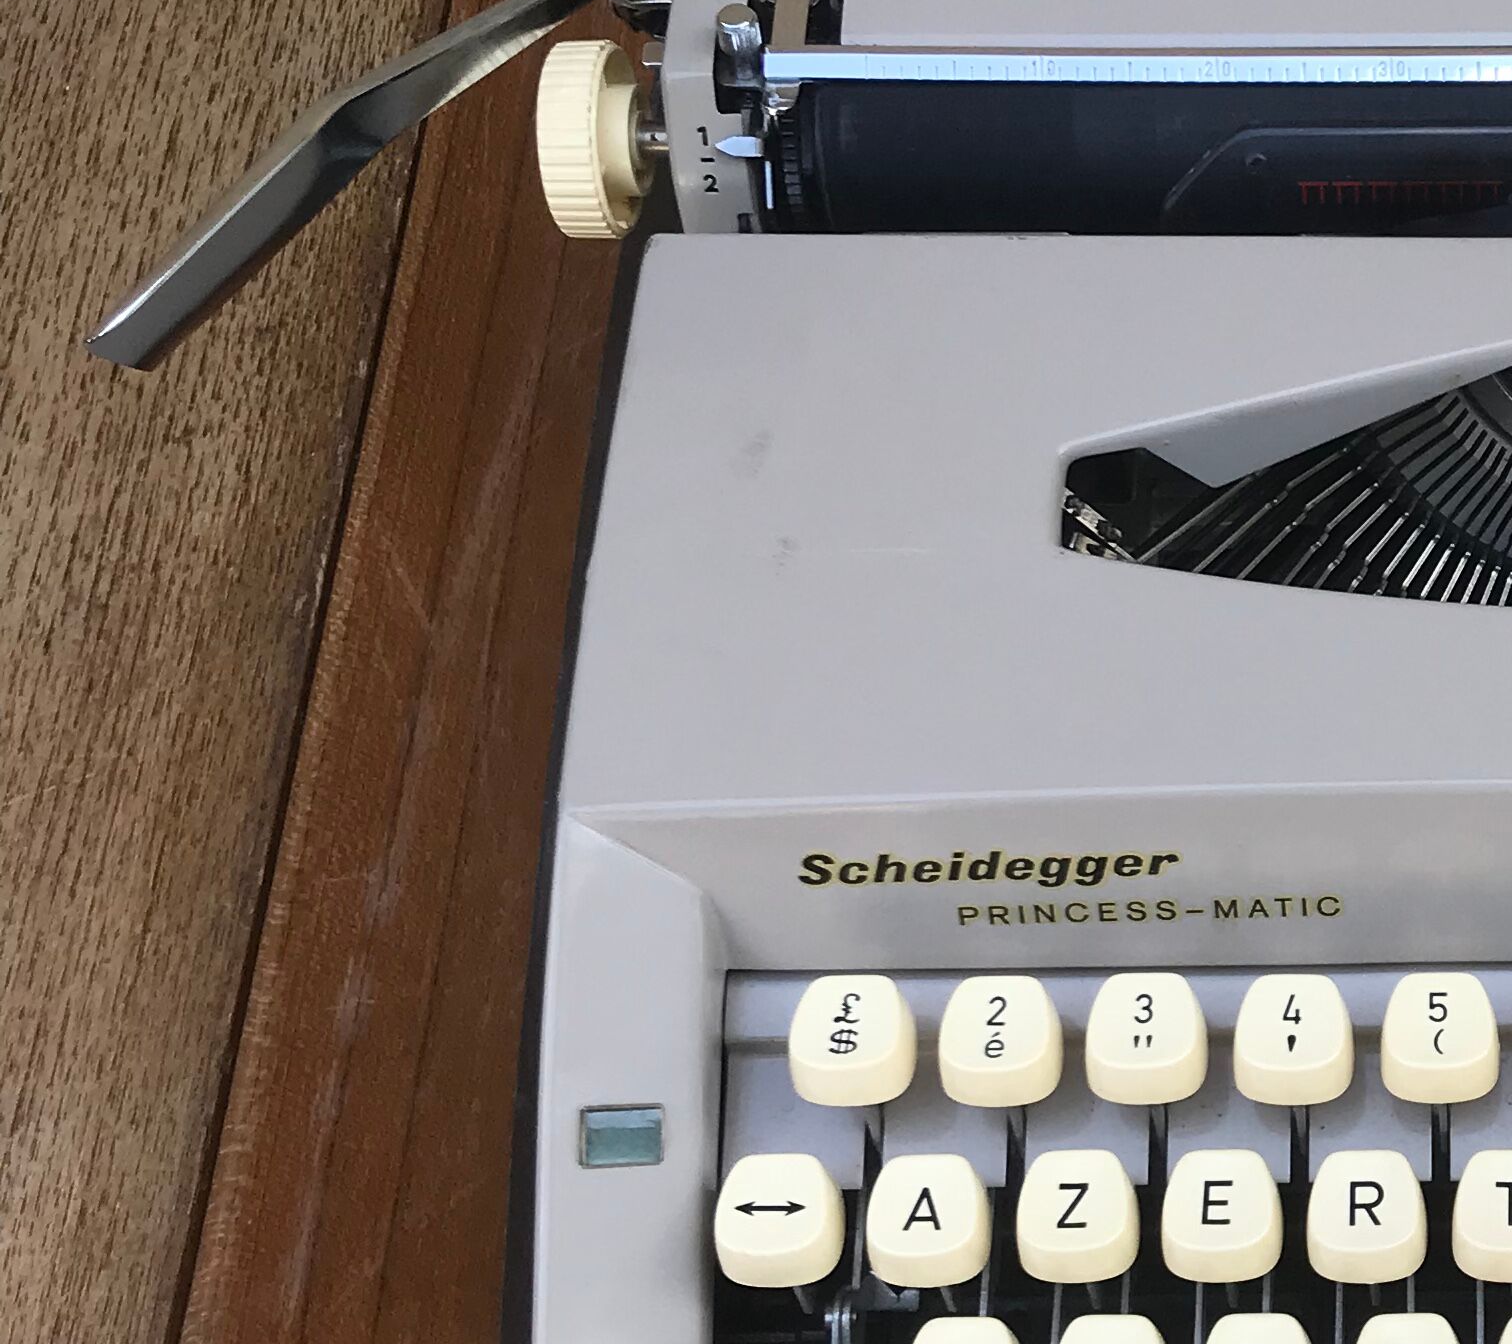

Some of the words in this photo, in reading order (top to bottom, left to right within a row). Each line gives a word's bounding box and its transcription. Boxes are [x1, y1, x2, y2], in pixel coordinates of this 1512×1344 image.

[1030, 59, 1056, 77] 10
[1203, 59, 1232, 78] 20
[1377, 57, 1406, 77] 30
[696, 126, 709, 147] 1
[703, 174, 720, 193] 2
[798, 850, 1180, 888] Scheidegger
[957, 896, 1341, 926] PRINCESS-MATIC
[833, 993, 861, 1024] £
[986, 996, 1007, 1027] 2
[1134, 993, 1153, 1024] 3
[1282, 994, 1302, 1025] 4
[1428, 992, 1448, 1023] 5
[828, 1028, 858, 1055] $
[984, 1031, 1005, 1059] é
[1433, 1028, 1444, 1055] (
[902, 1187, 941, 1231] A
[1056, 1182, 1089, 1229] Z
[1201, 1180, 1233, 1225] E
[1349, 1180, 1385, 1227] R
